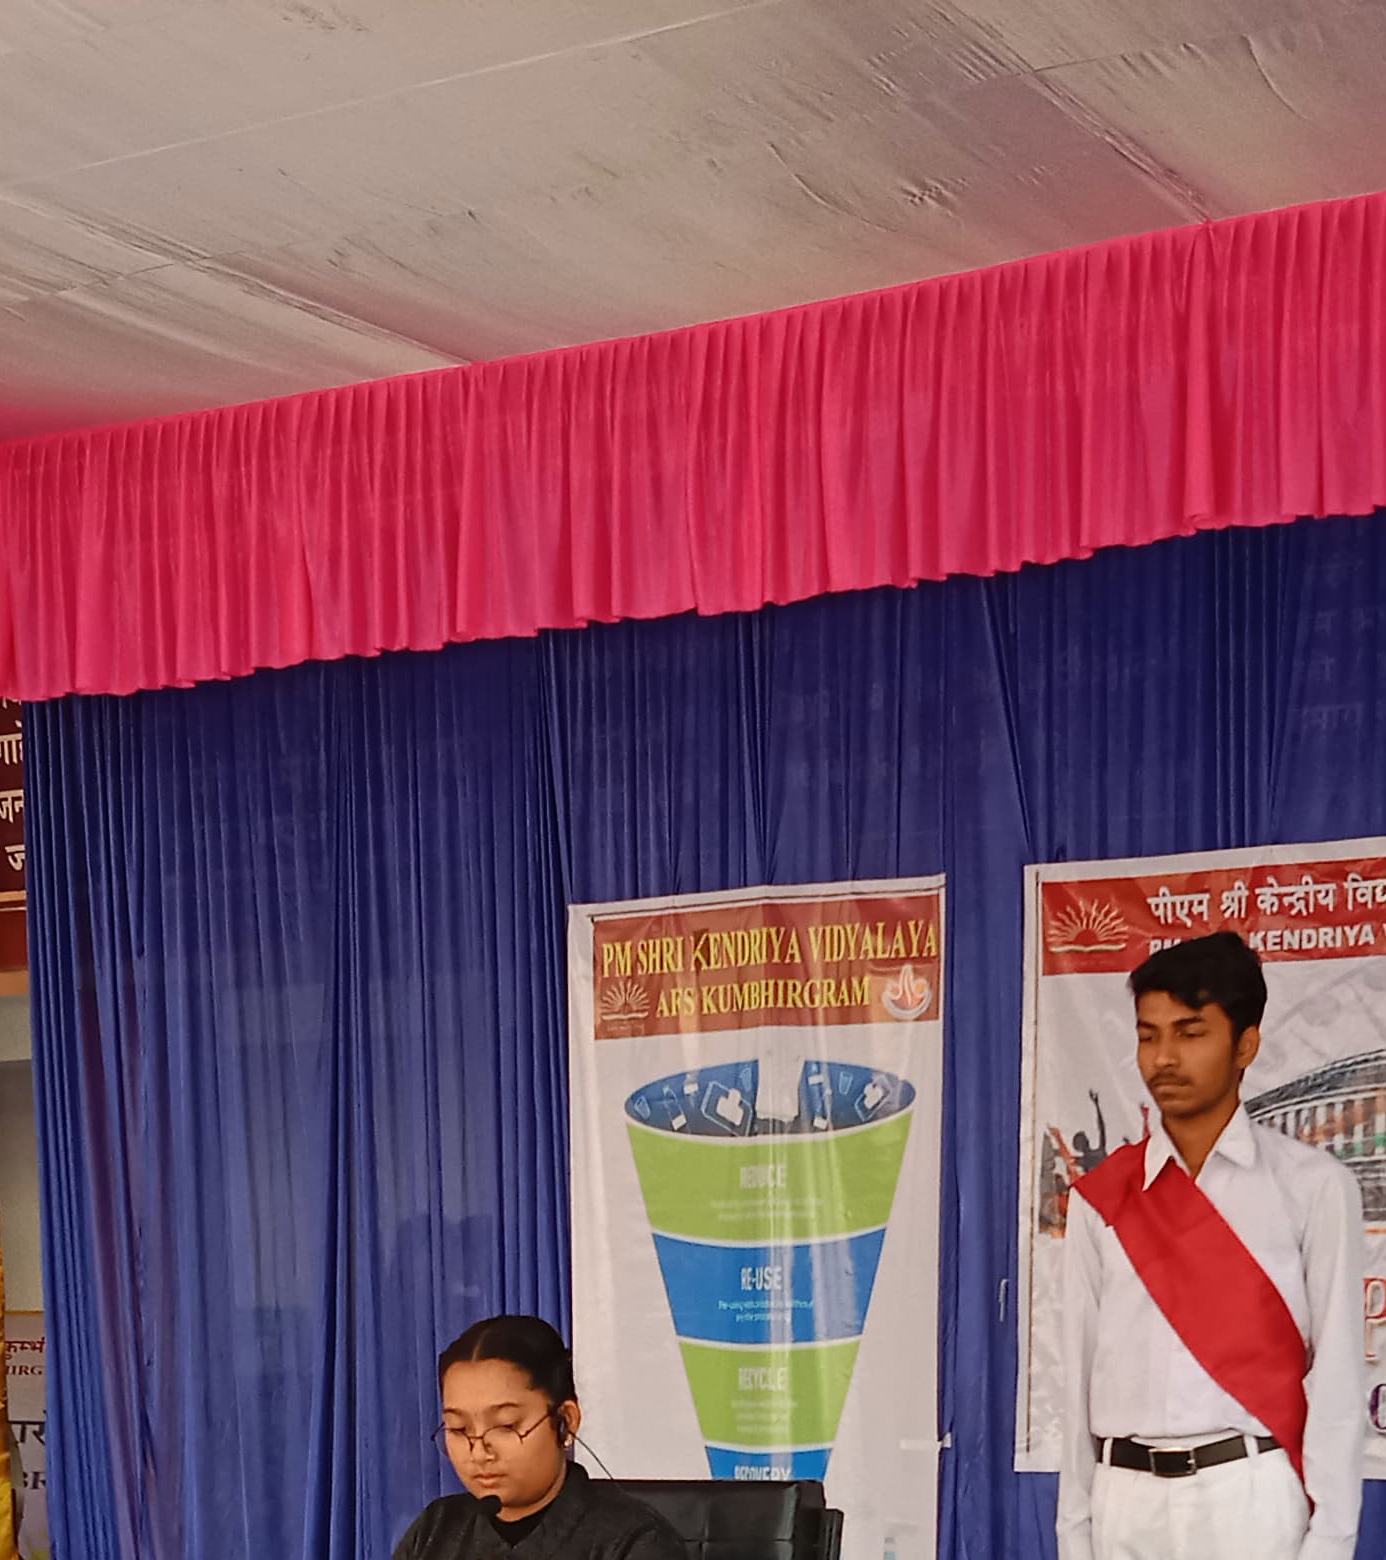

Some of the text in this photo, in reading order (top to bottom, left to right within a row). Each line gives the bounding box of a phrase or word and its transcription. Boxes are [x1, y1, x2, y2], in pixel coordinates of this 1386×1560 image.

[1147, 886, 1210, 927] पीएम
[1220, 880, 1249, 919] श्री
[1255, 875, 1336, 917] केन्द्रीय
[602, 920, 938, 978] PM SHRI KENDRIYA VIDYALAYA
[1248, 924, 1375, 952] KENDRIYA
[656, 976, 871, 1018] AFS KUMBHIRGRAM
[740, 1267, 782, 1291] RE-USE
